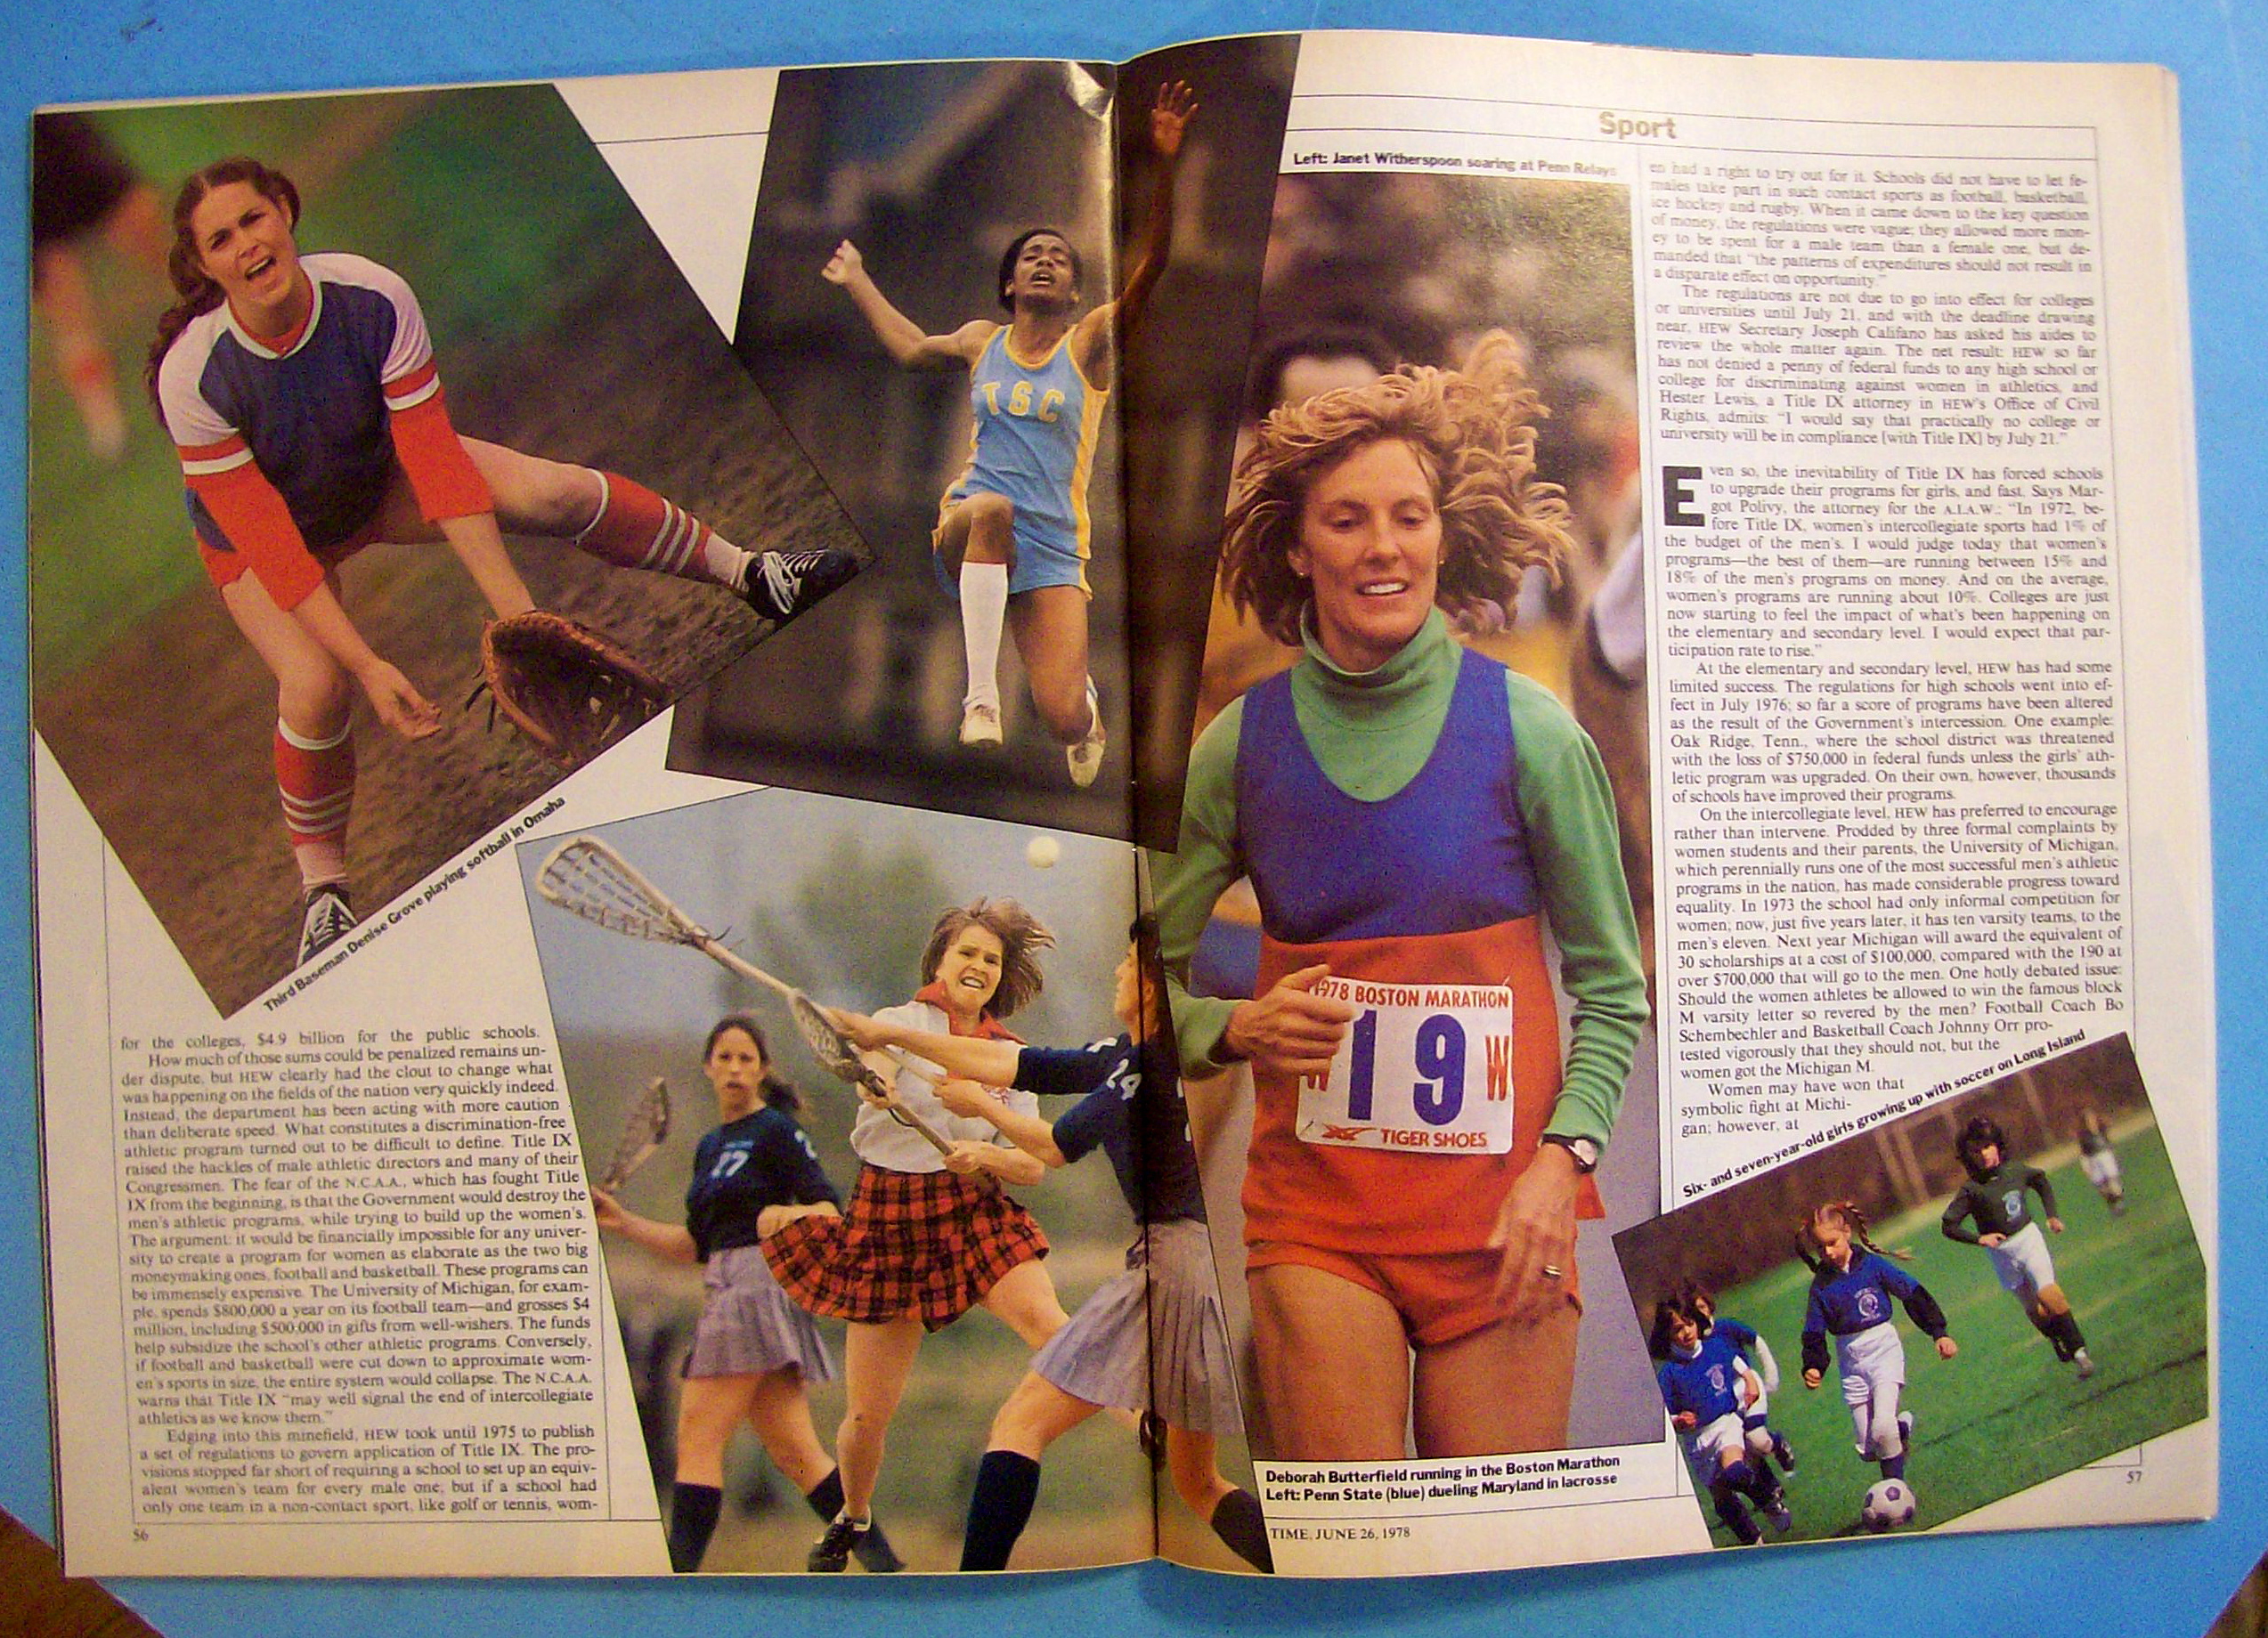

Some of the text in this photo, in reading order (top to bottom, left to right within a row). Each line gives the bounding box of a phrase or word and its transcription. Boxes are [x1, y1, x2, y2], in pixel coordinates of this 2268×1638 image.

[1599, 111, 1677, 140] Sport
[1293, 152, 1328, 166] Left:
[1332, 151, 1370, 164] Janet
[1374, 151, 1462, 167] Witherspoon
[1467, 157, 1516, 173] soaring
[1519, 159, 1534, 171] at
[1684, 283, 2094, 309] The regulations are not due to go into effect for colleges
[1740, 466, 1760, 479] so,
[1765, 464, 1788, 478] the
[1794, 464, 1878, 482] inevitability
[1884, 466, 1899, 480] of
[1906, 466, 1939, 480] Title
[1946, 466, 1964, 480] IX
[1971, 466, 1996, 480] has
[2002, 466, 2046, 480] forced
[2053, 466, 2104, 480] schools
[1662, 466, 1705, 526] E
[1670, 730, 2115, 750] Oak Ridge, Tenn., where the school district was threatened
[1673, 819, 2118, 840] rather than intervene. Prodded by three formal complaints by
[263, 796, 566, 1012] Third Baseman Denise Grove playing softball in Omaha
[1677, 925, 2121, 951] men's eleven. Next year Michigan will award the equivalent of
[1354, 985, 1419, 1007] BOSTON
[1425, 989, 1509, 1009] MARATHON
[120, 1035, 141, 1050] for
[151, 1035, 174, 1050] the
[185, 1034, 246, 1050] colleges,
[298, 1030, 345, 1045] billion
[357, 1028, 378, 1043] for
[390, 1028, 413, 1042] the
[426, 1026, 470, 1044] public
[482, 1025, 540, 1040] schools.
[1679, 1018, 2053, 1043] Schembechler and Basketball Coach Johnny Orr pro-
[1484, 1034, 1510, 1102] W
[1680, 1058, 1874, 1081] women got the Michigan M.
[1707, 1076, 1905, 1097] Women may have won that
[1680, 1096, 1851, 1117] symbolic fight at Michi-
[1682, 1029, 2085, 1197] Six- and seven-year-old girls growing up with soccer on Long Island
[1381, 1128, 1488, 1149] TIGER SHOES
[167, 1429, 217, 1445] Edging
[222, 1429, 251, 1443] into
[255, 1429, 281, 1442] this
[363, 1428, 399, 1441] HEW
[404, 1425, 437, 1440] took
[443, 1423, 476, 1439] until
[484, 1424, 516, 1439] 1975
[521, 1426, 537, 1439] to
[541, 1423, 595, 1441] publish
[1265, 1455, 1620, 1483] Deborah Butterfield running in the Boston Marathon
[2126, 1470, 2142, 1484] 57
[1265, 1474, 1617, 1502] Left: Penn State (blue) dueling Maryland in lacrosse
[134, 1528, 150, 1542] 56
[1315, 1528, 1357, 1540] JUNE
[1360, 1528, 1378, 1541] 26,
[1382, 1526, 1410, 1539] 1978
